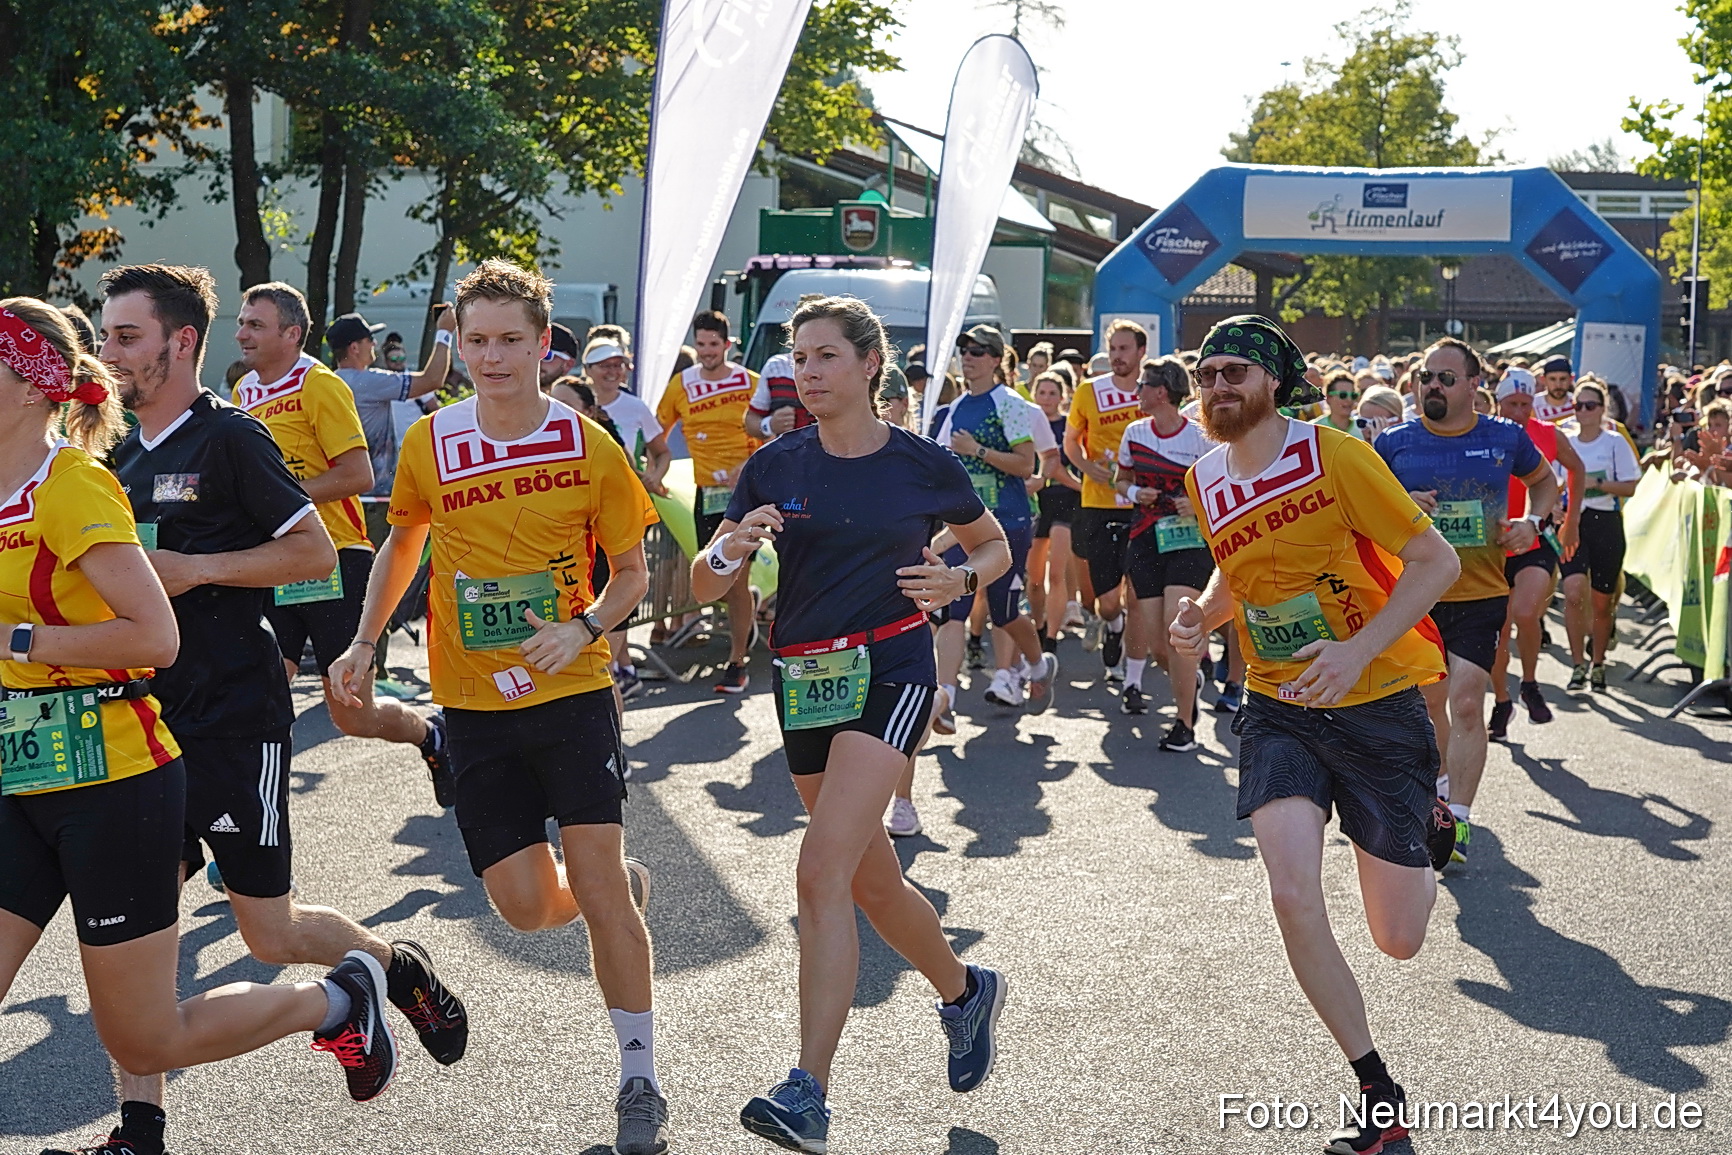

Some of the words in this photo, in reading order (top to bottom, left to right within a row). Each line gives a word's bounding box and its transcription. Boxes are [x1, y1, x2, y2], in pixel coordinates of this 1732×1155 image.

[1346, 208, 1445, 228] firmenlauf
[1155, 229, 1210, 250] Fischer
[1099, 411, 1131, 425] MAX
[441, 480, 506, 514] MAX
[514, 468, 590, 496] BÖGL
[1168, 526, 1191, 538] 131
[1213, 521, 1263, 564] MAX
[1264, 489, 1335, 532] BÖGL
[1440, 516, 1472, 533] 644
[481, 599, 531, 627] 813
[463, 612, 475, 637] RUN
[1261, 621, 1308, 645] 804
[812, 646, 830, 654] balance
[806, 676, 850, 703] 486
[854, 677, 866, 711] 2022
[789, 689, 798, 715] RUN
[797, 704, 828, 715] Schlierf
[51, 730, 68, 773] 2022
[209, 825, 241, 833] adidas
[99, 915, 126, 927] JAKO
